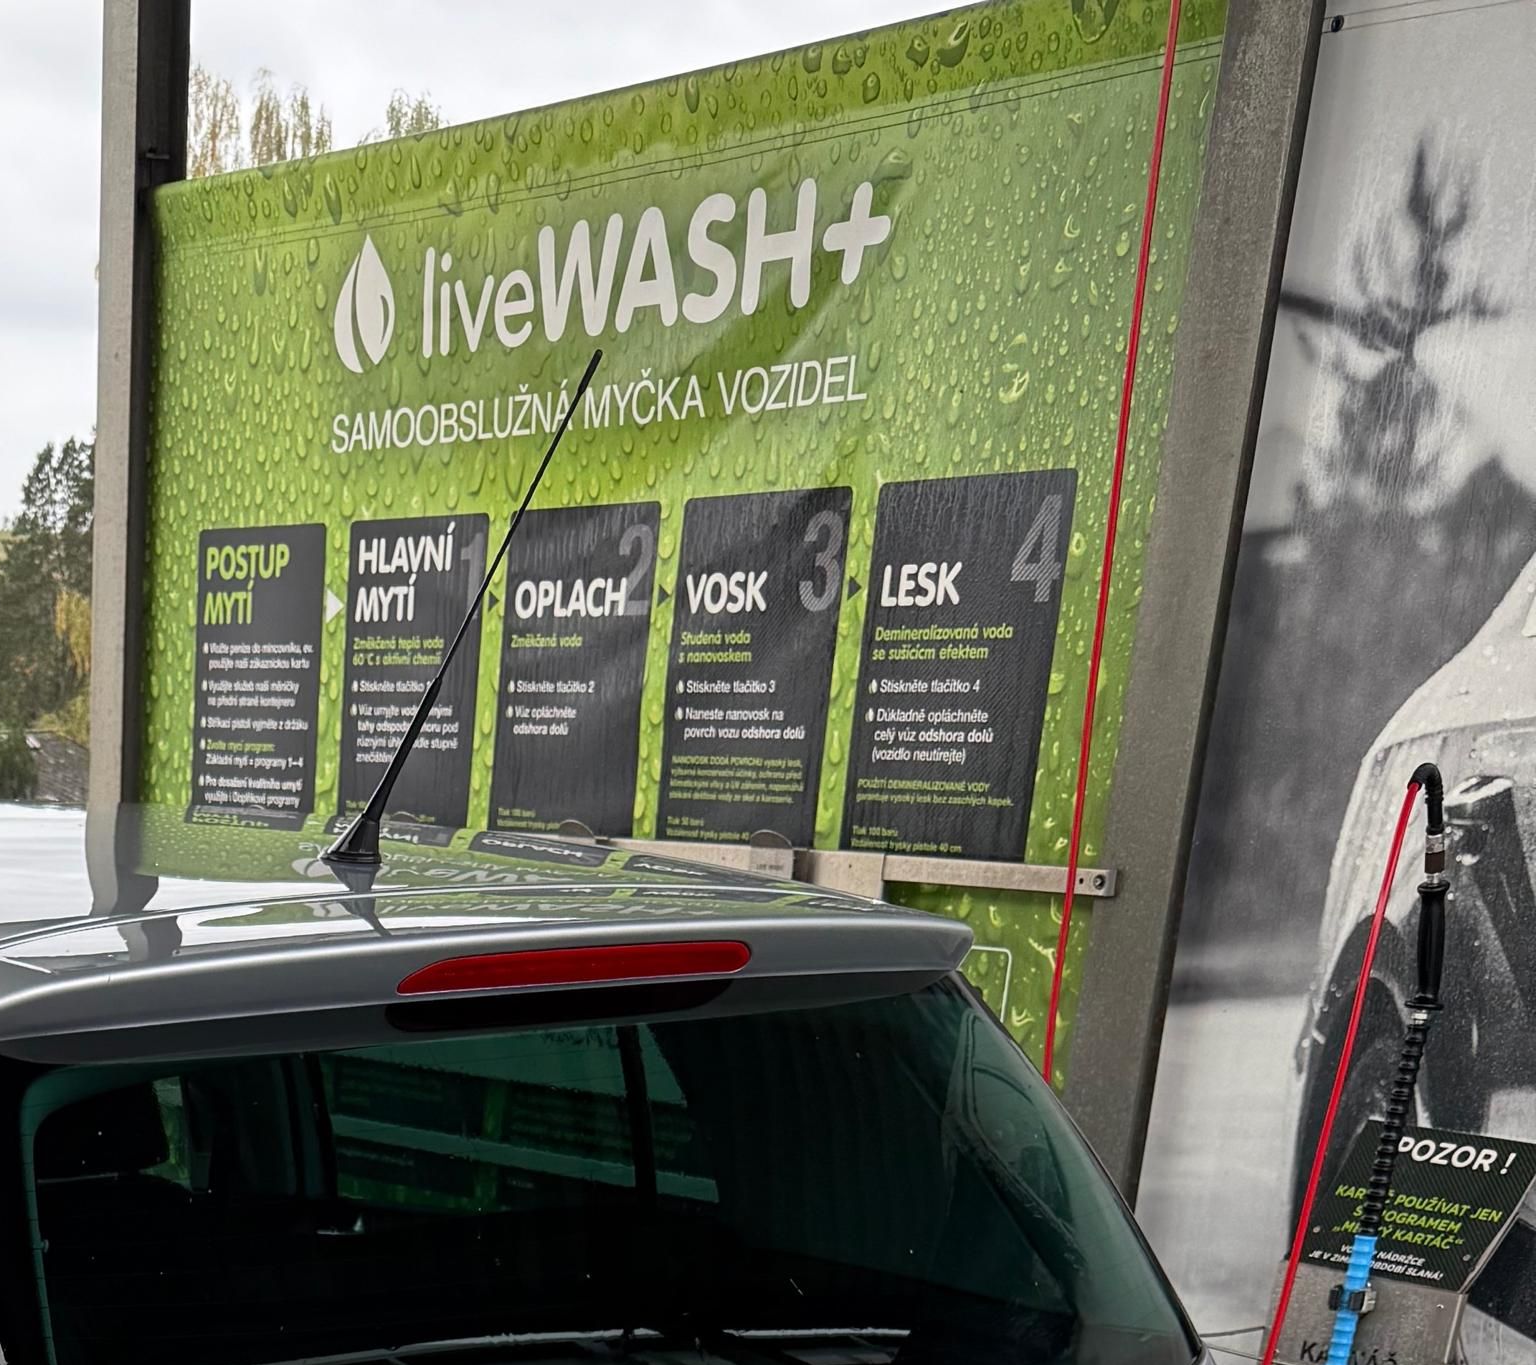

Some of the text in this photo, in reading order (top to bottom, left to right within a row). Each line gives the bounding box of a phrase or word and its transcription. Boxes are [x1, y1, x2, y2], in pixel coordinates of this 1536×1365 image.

[421, 178, 891, 359] liveWASH+
[331, 354, 868, 455] SAMOOBSLUŽNÁ MYČKA VOZIDEL
[357, 521, 456, 575] HLAVNÍ
[1010, 494, 1064, 603] 4
[206, 543, 290, 582] POSTUP
[797, 510, 842, 612] 3
[686, 570, 768, 615] VOSK
[880, 561, 963, 607] LESK
[203, 580, 255, 625] MYTÍ
[354, 573, 417, 622] MYTÍ
[514, 577, 628, 620] OPLACH
[680, 630, 751, 646] Studená voda
[875, 622, 1014, 641] Demineralizovaná voda
[872, 648, 885, 661] se
[939, 645, 988, 660] efektem
[588, 680, 595, 693] 2
[686, 680, 731, 694] Stiskněte
[768, 680, 776, 693] 3
[879, 678, 980, 694] Stiskněte tlačítko 4
[771, 710, 784, 721] na
[876, 707, 989, 725] Důkladně opláchněte
[741, 726, 781, 739] odshora
[874, 727, 994, 744] celý vůz odshora dolů
[871, 746, 911, 763] (vozidlo
[1352, 1205, 1364, 1217] S
[1394, 1192, 1471, 1218] POUŽÍVAT
[1470, 1209, 1503, 1223] JEN
[1308, 1250, 1322, 1259] JE
[1376, 1250, 1426, 1267] NÁDRŽCE
